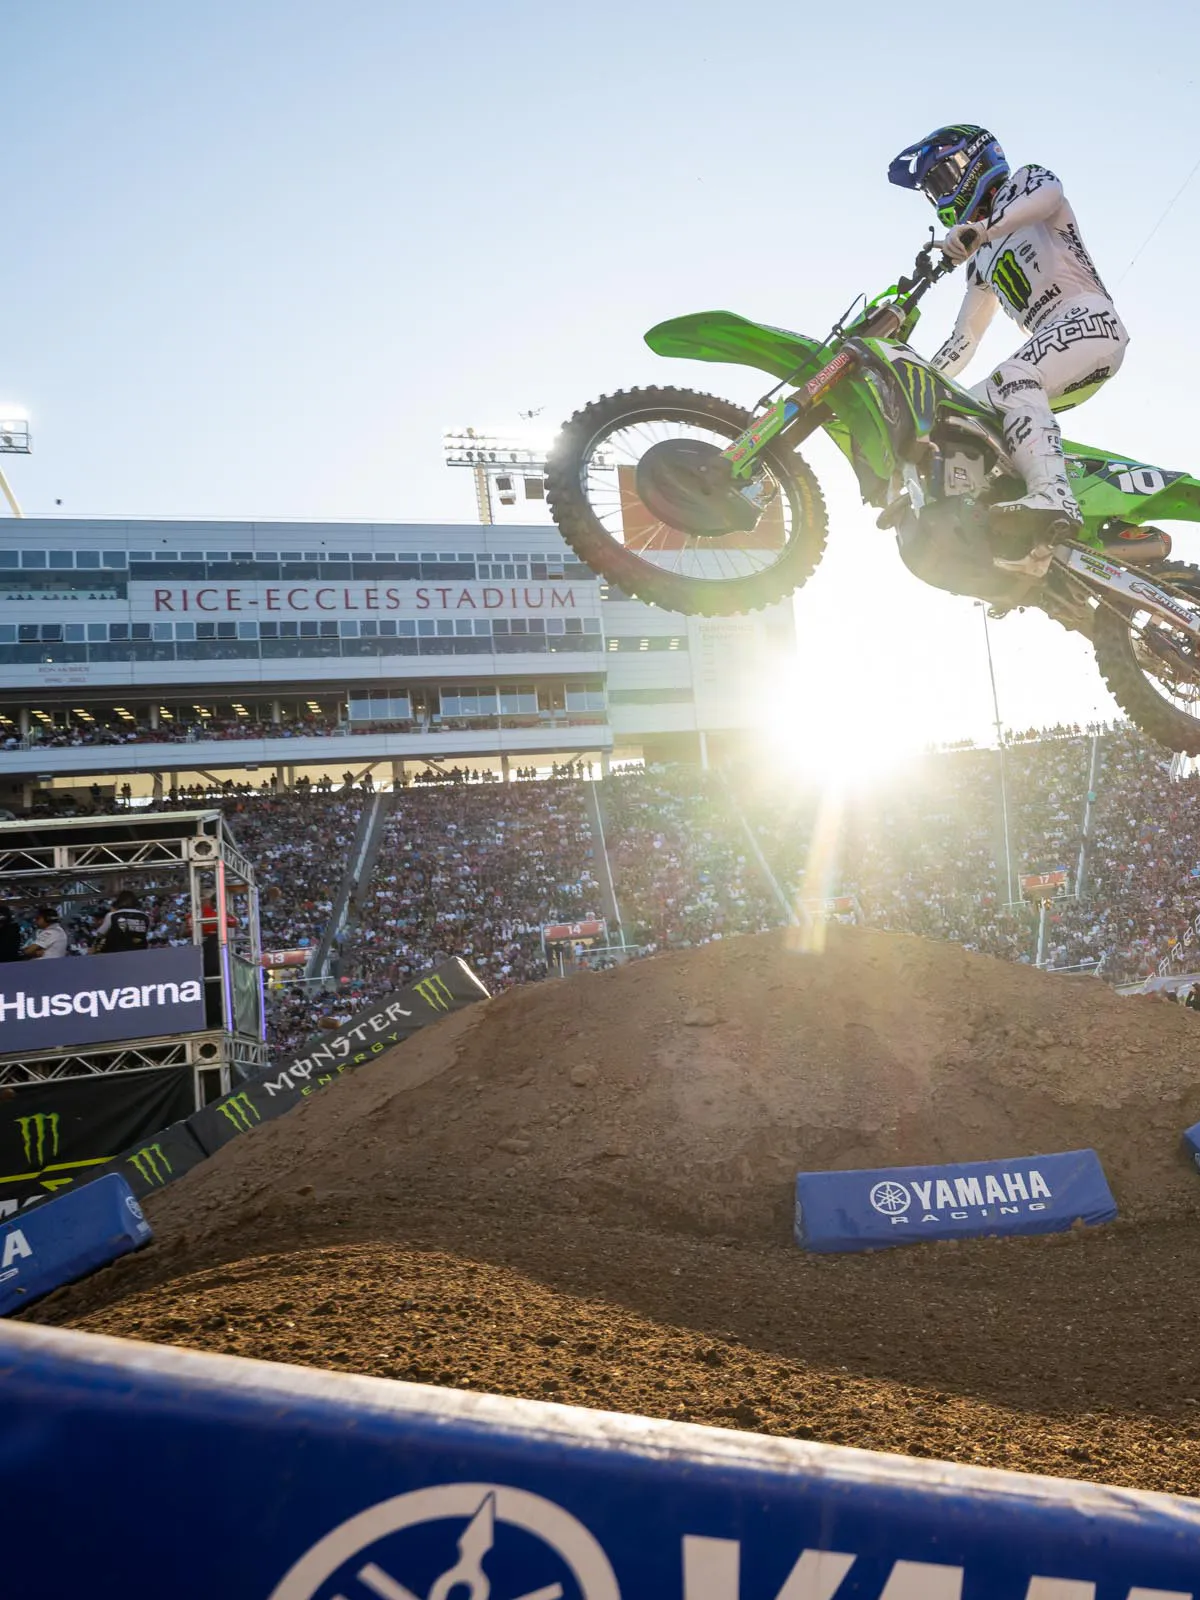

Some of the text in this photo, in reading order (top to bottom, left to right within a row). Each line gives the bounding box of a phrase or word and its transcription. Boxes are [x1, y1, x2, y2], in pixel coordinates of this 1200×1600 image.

[1108, 463, 1166, 495] 10
[154, 587, 576, 611] RICE-ECCLES STADIUM
[1039, 874, 1050, 884] 17
[567, 924, 581, 935] 14
[268, 952, 285, 964] 13
[0, 979, 202, 1022] Husqvarna
[263, 1001, 413, 1097] MONSTER
[301, 1031, 399, 1096] ENERGY
[910, 1170, 1052, 1210] YAMAHA
[891, 1202, 1047, 1224] RACING
